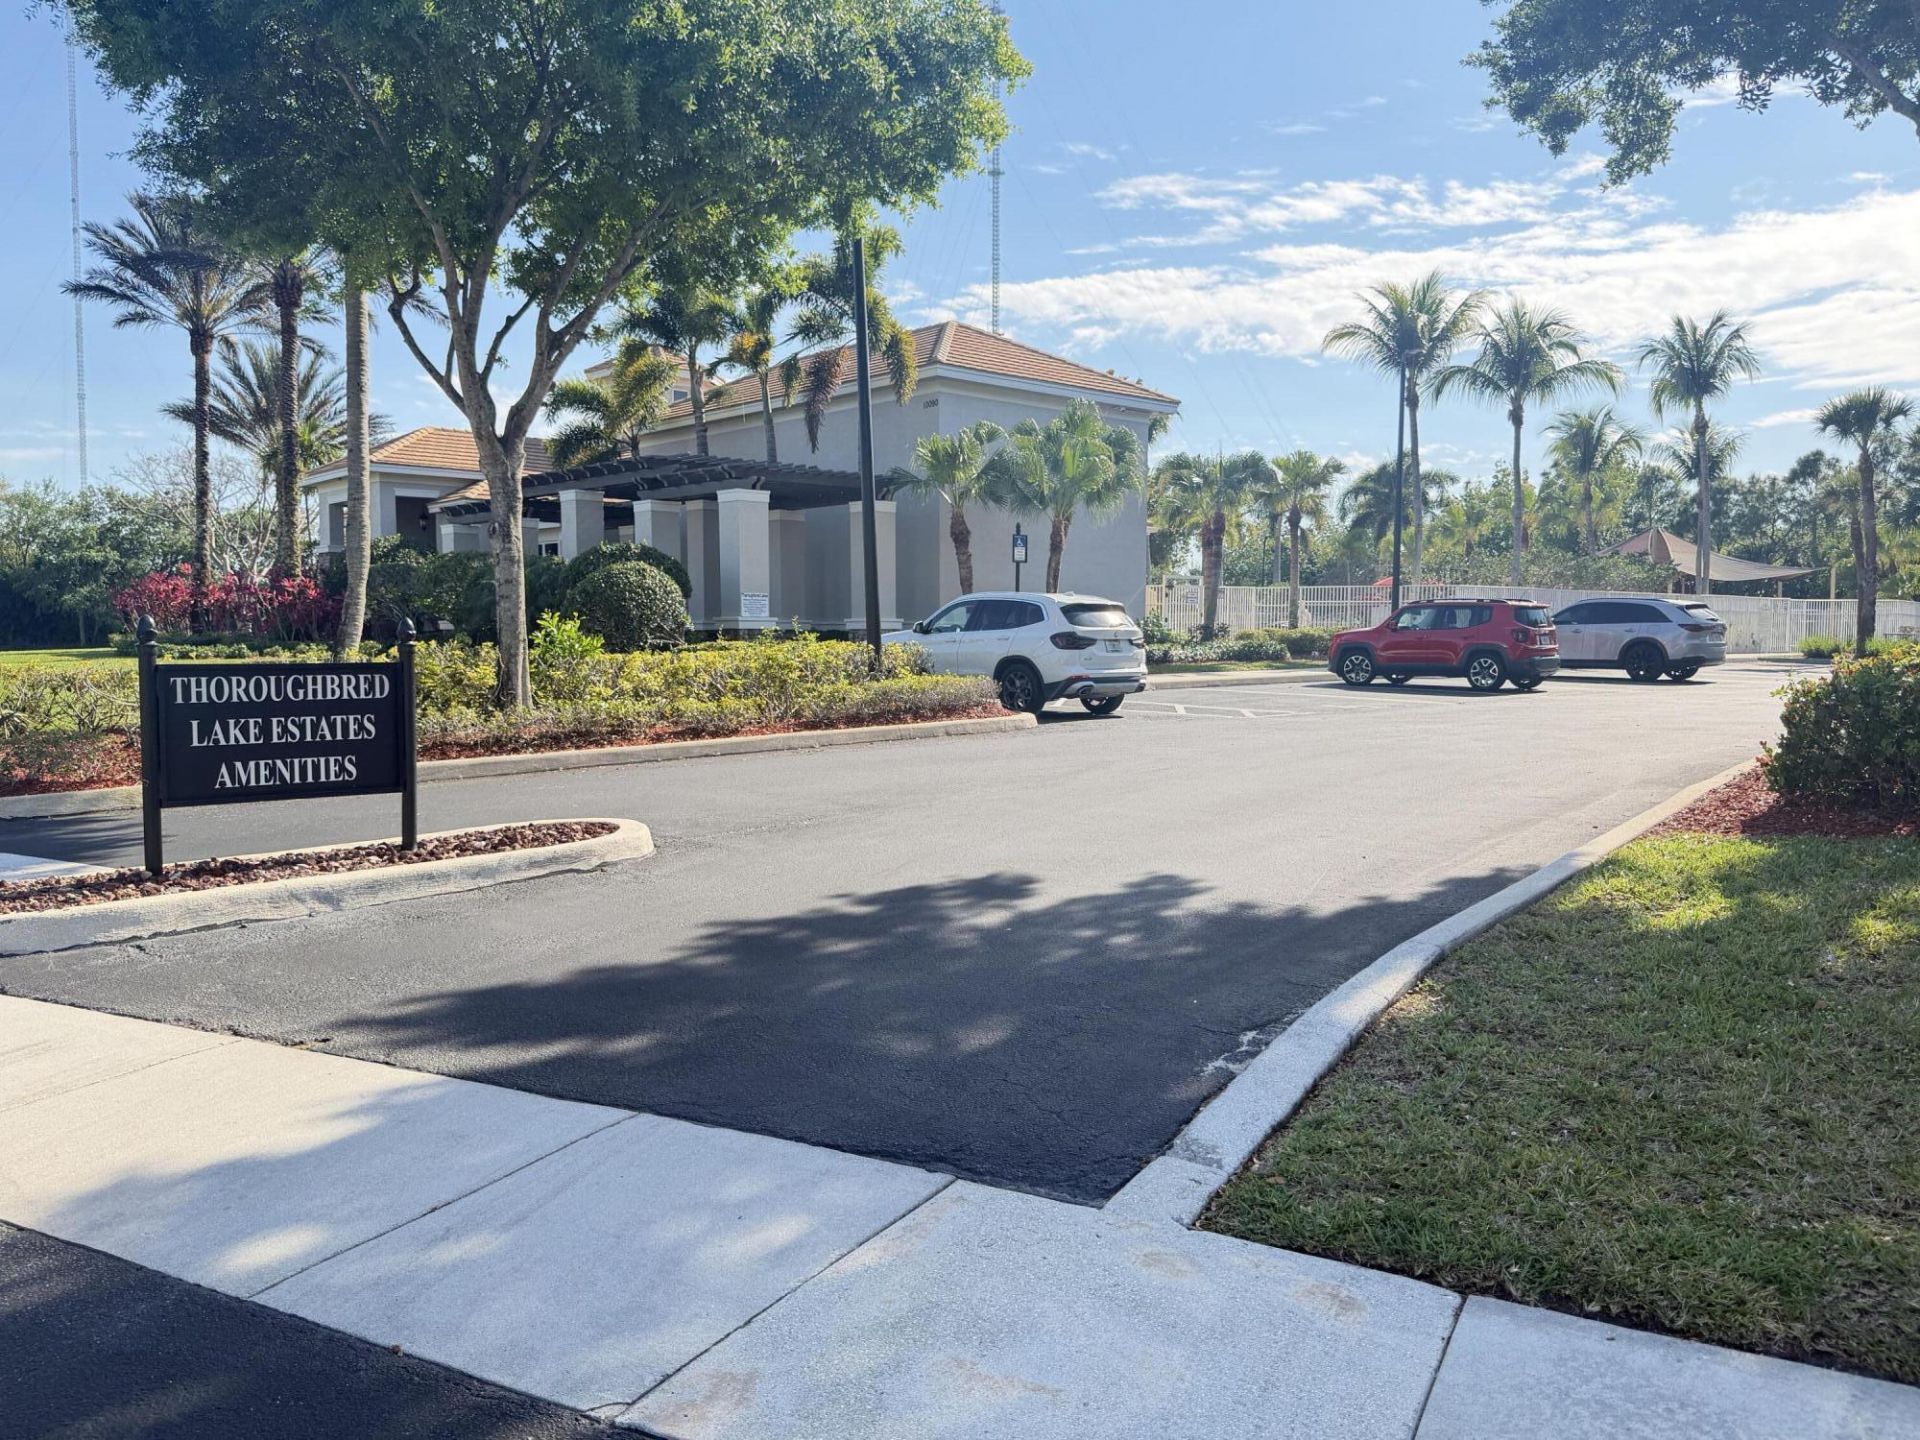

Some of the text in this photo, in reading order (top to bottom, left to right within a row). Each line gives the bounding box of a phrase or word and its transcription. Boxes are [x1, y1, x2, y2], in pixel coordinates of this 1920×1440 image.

[170, 674, 390, 704] THOROUGHBRED
[190, 714, 376, 747] LAKE ESTATES
[214, 755, 358, 789] AMENITIES
